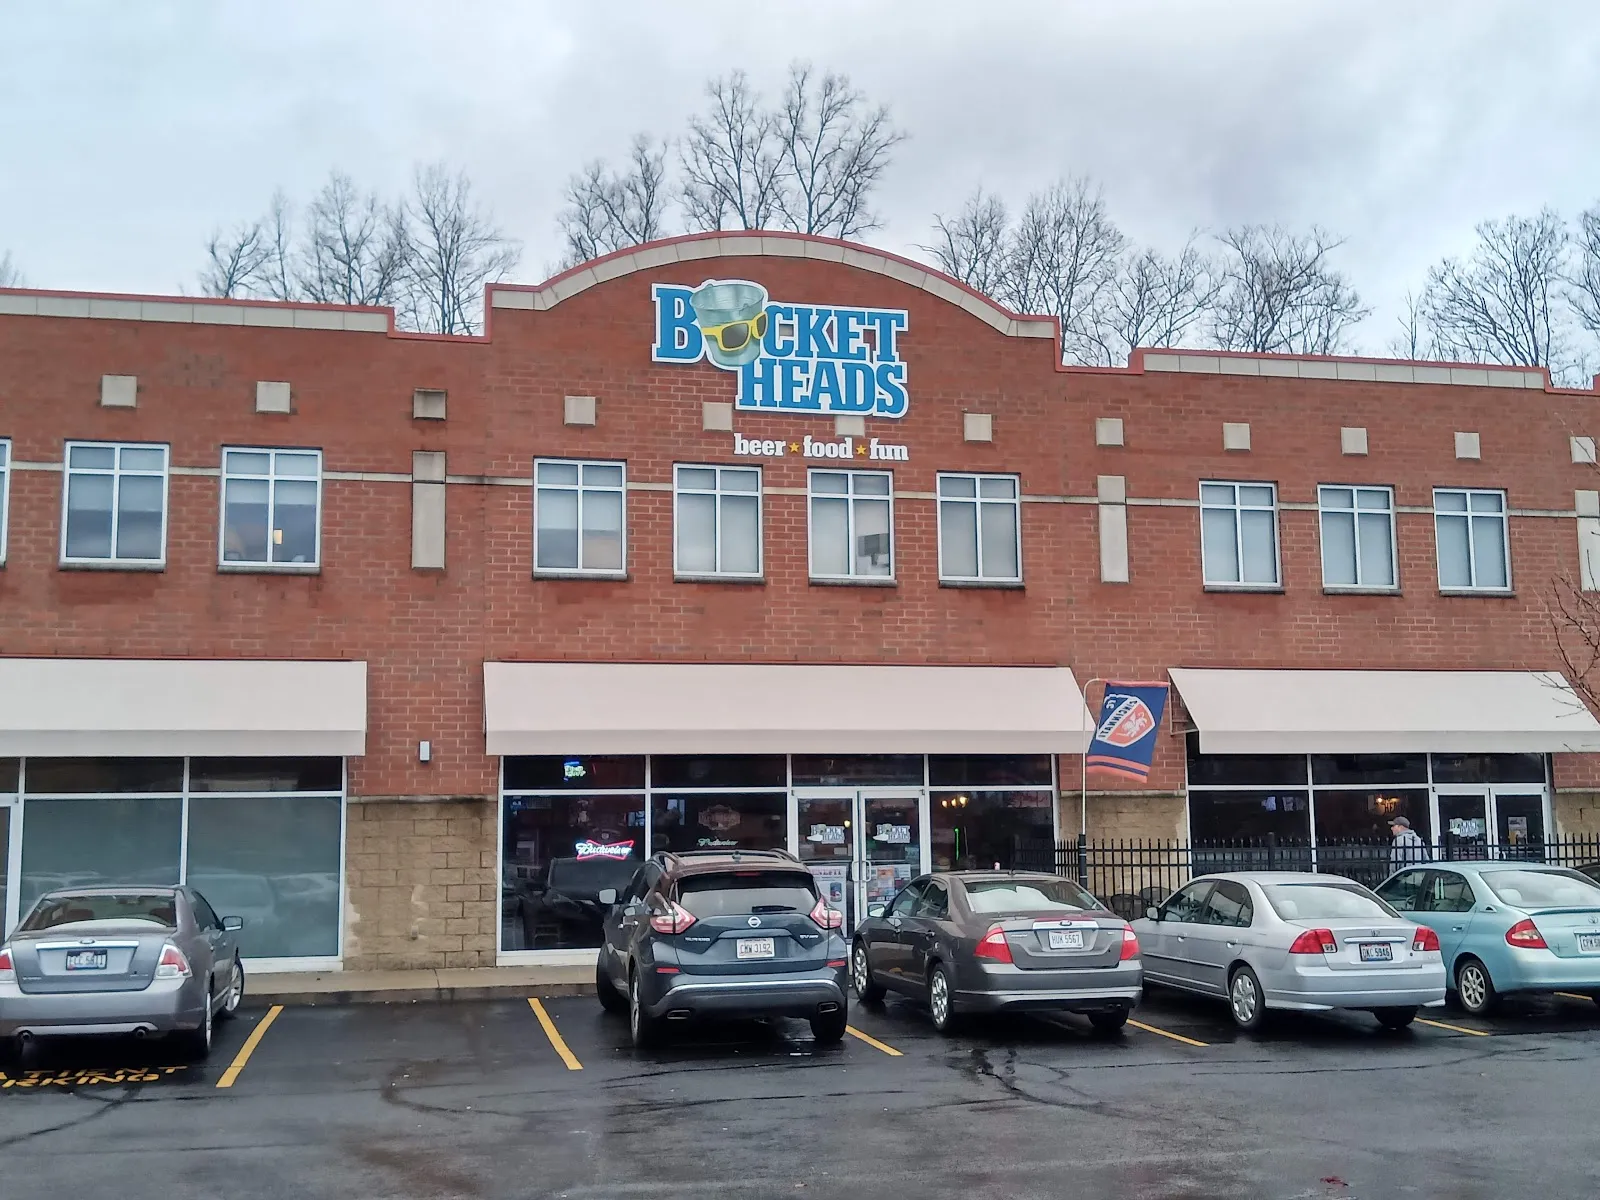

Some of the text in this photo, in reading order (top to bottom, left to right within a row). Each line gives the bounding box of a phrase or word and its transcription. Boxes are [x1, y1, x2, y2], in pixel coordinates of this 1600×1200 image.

[653, 280, 908, 366] BCKET
[736, 357, 908, 416] HEADS
[733, 433, 909, 460] beer food fun
[575, 842, 632, 856] Budweiser
